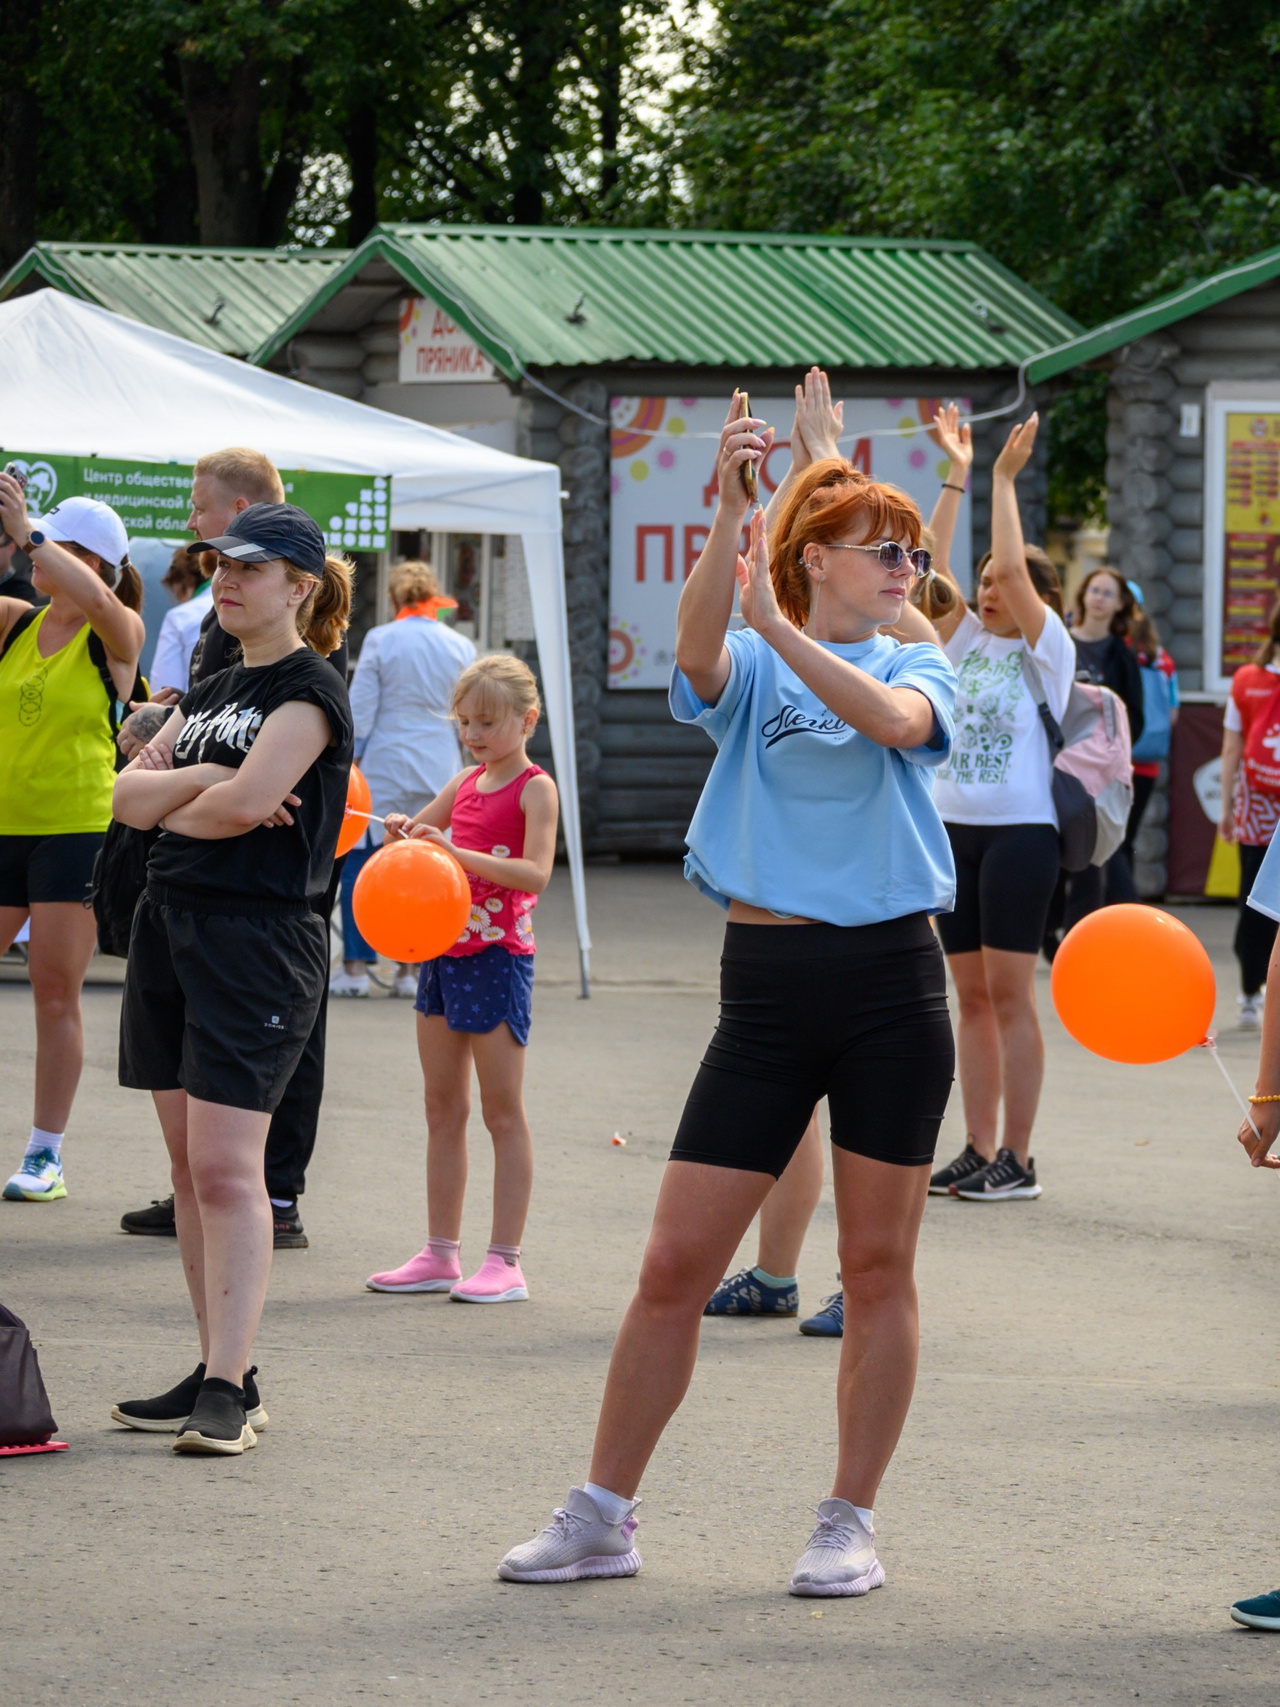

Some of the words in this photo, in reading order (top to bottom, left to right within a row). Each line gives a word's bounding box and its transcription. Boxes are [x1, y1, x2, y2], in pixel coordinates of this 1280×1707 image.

[416, 346, 486, 374] ПРЯНИКА
[83, 467, 123, 486] Центр
[125, 471, 195, 488] обществе
[155, 517, 190, 531] обла
[974, 751, 1012, 770] BEST.
